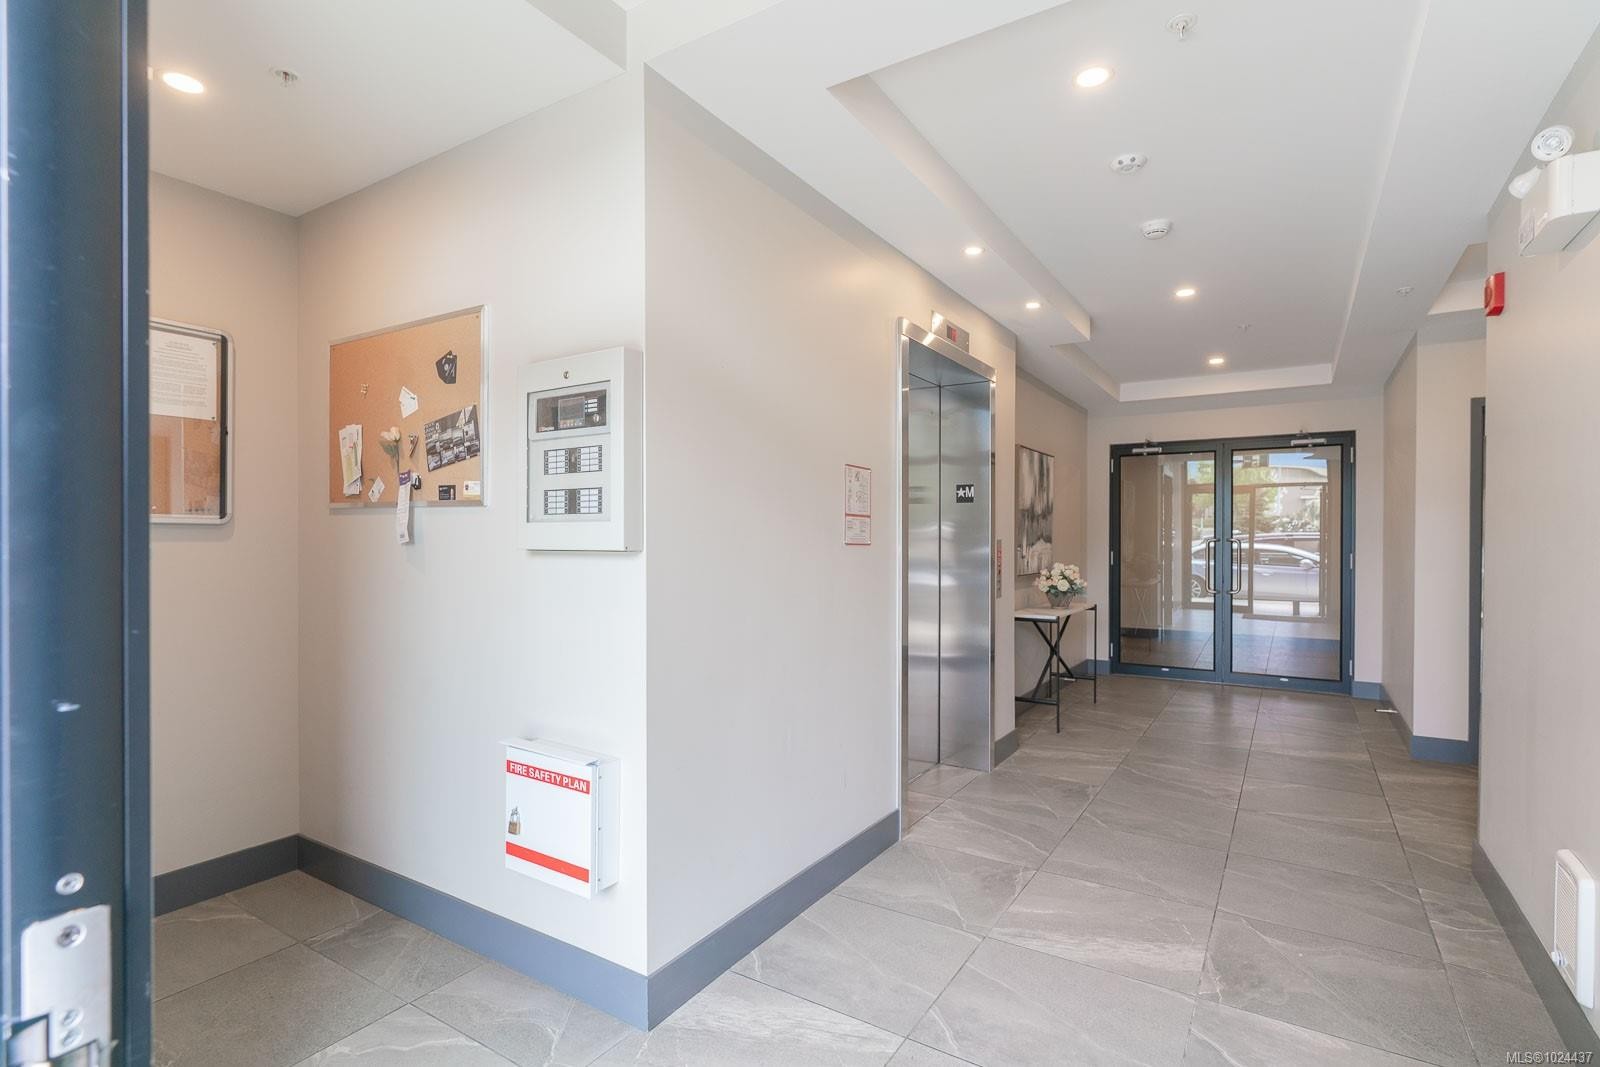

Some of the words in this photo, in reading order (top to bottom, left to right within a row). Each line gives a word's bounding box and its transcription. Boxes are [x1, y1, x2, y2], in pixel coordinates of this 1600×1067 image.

[509, 762, 528, 775] FIRE
[528, 767, 562, 785] SAFETY
[562, 775, 587, 792] PLAN
